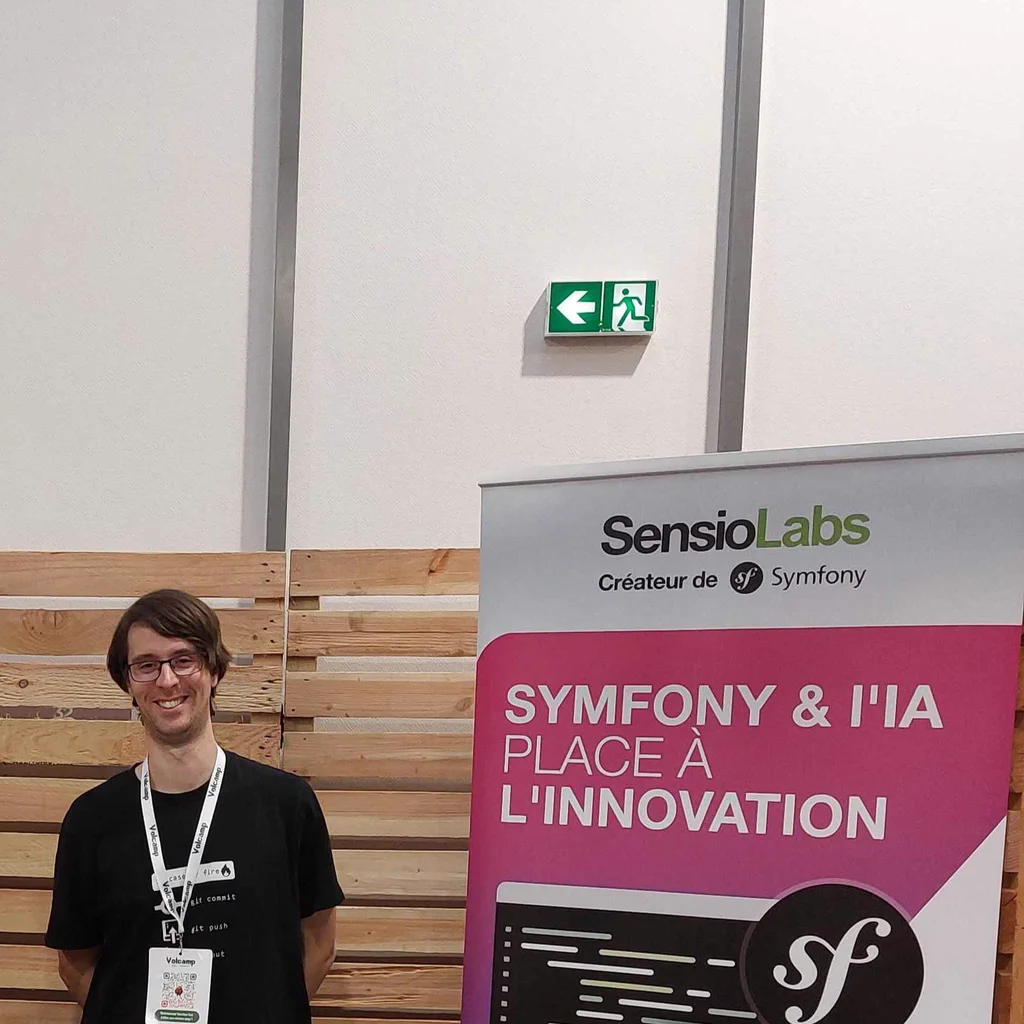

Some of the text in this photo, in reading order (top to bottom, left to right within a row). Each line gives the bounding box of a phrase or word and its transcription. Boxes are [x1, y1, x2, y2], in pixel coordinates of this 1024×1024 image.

[601, 505, 870, 555] SensioLabs
[598, 571, 688, 592] Créateur
[693, 571, 717, 588] de
[772, 565, 866, 590] Symfony
[505, 684, 776, 726] SYMFONY
[793, 685, 831, 727] &
[504, 728, 713, 779] PLACE À
[207, 766, 223, 798] Volcamp
[501, 785, 887, 839] L'INNOVATION
[149, 824, 160, 857] Volcamp
[192, 822, 209, 855] Volcamp
[202, 868, 220, 877] fire
[206, 893, 236, 903] commit
[208, 923, 228, 932] push
[166, 956, 196, 967] Volcamp
